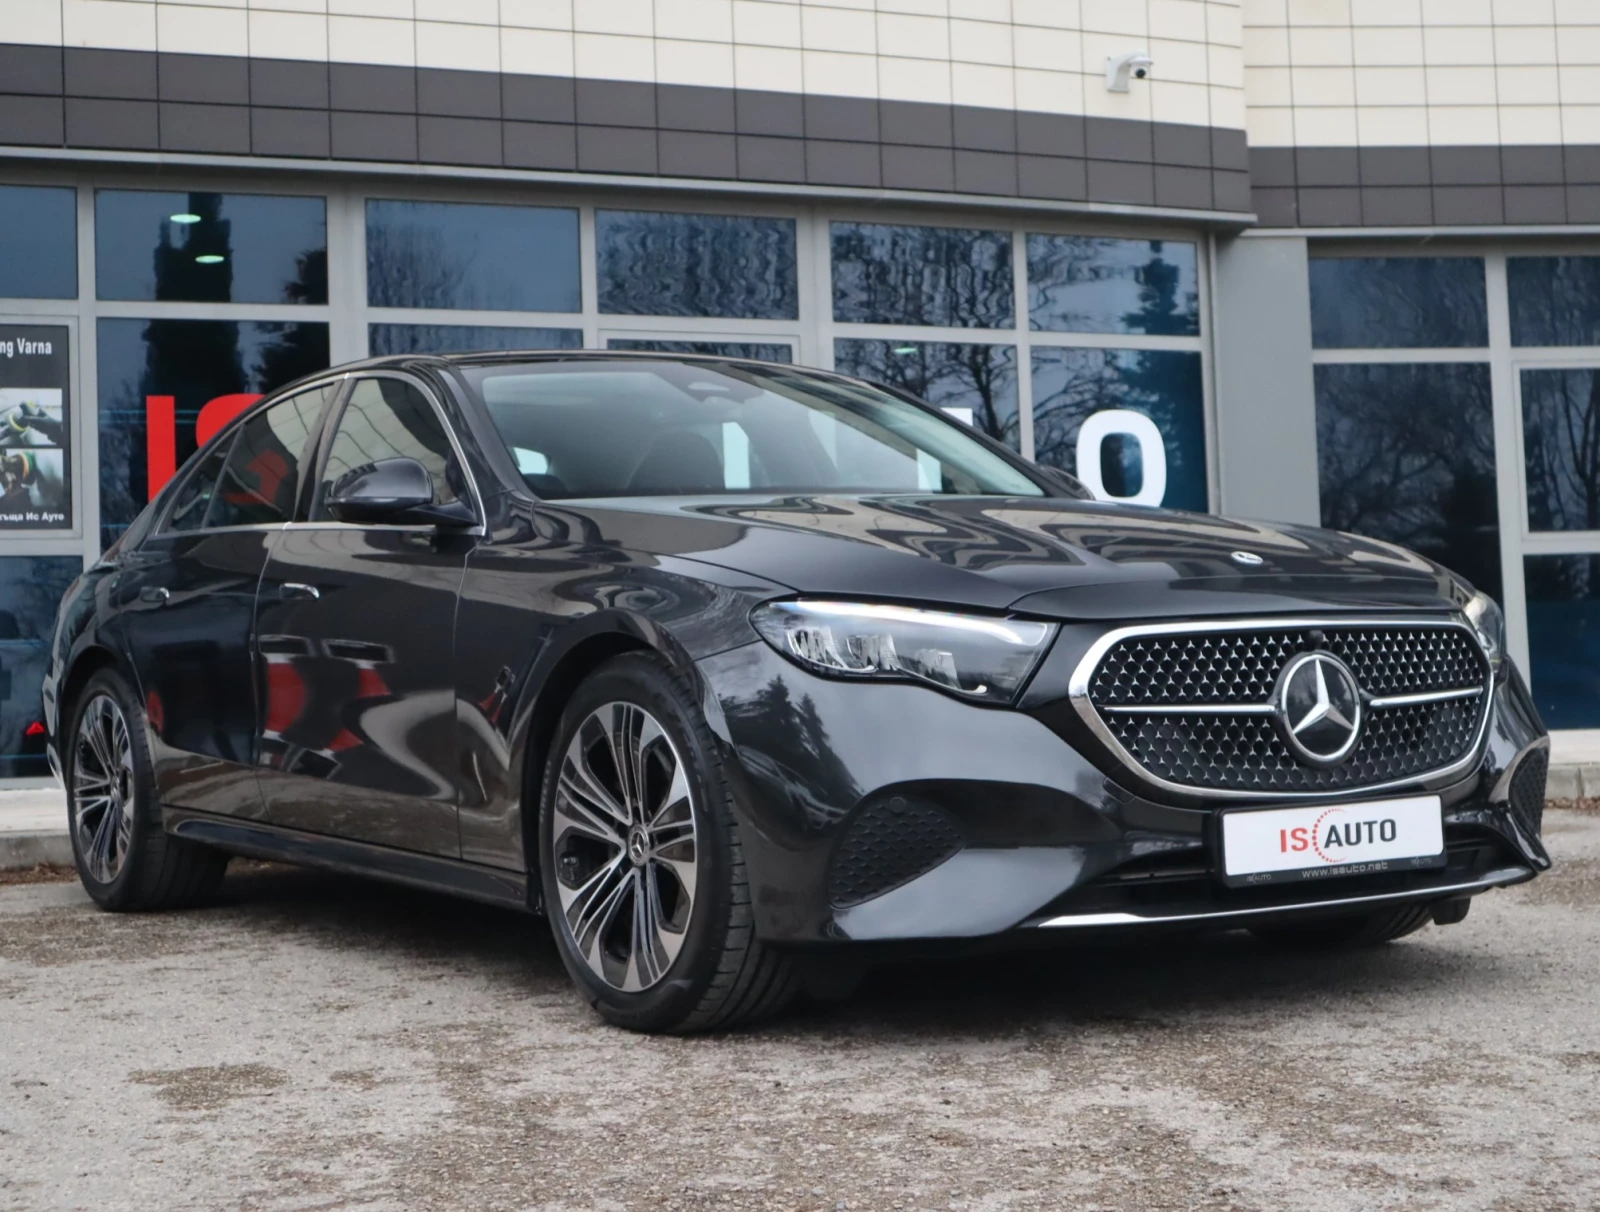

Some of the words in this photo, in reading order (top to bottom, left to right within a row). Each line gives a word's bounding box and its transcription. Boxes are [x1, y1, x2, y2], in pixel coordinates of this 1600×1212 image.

[16, 337, 52, 355] Varna
[26, 511, 39, 521] Ис
[42, 511, 64, 523] Ауто
[1280, 827, 1309, 853] IS
[1324, 819, 1397, 849] AUTO
[1302, 861, 1388, 878] www.isauto.net
